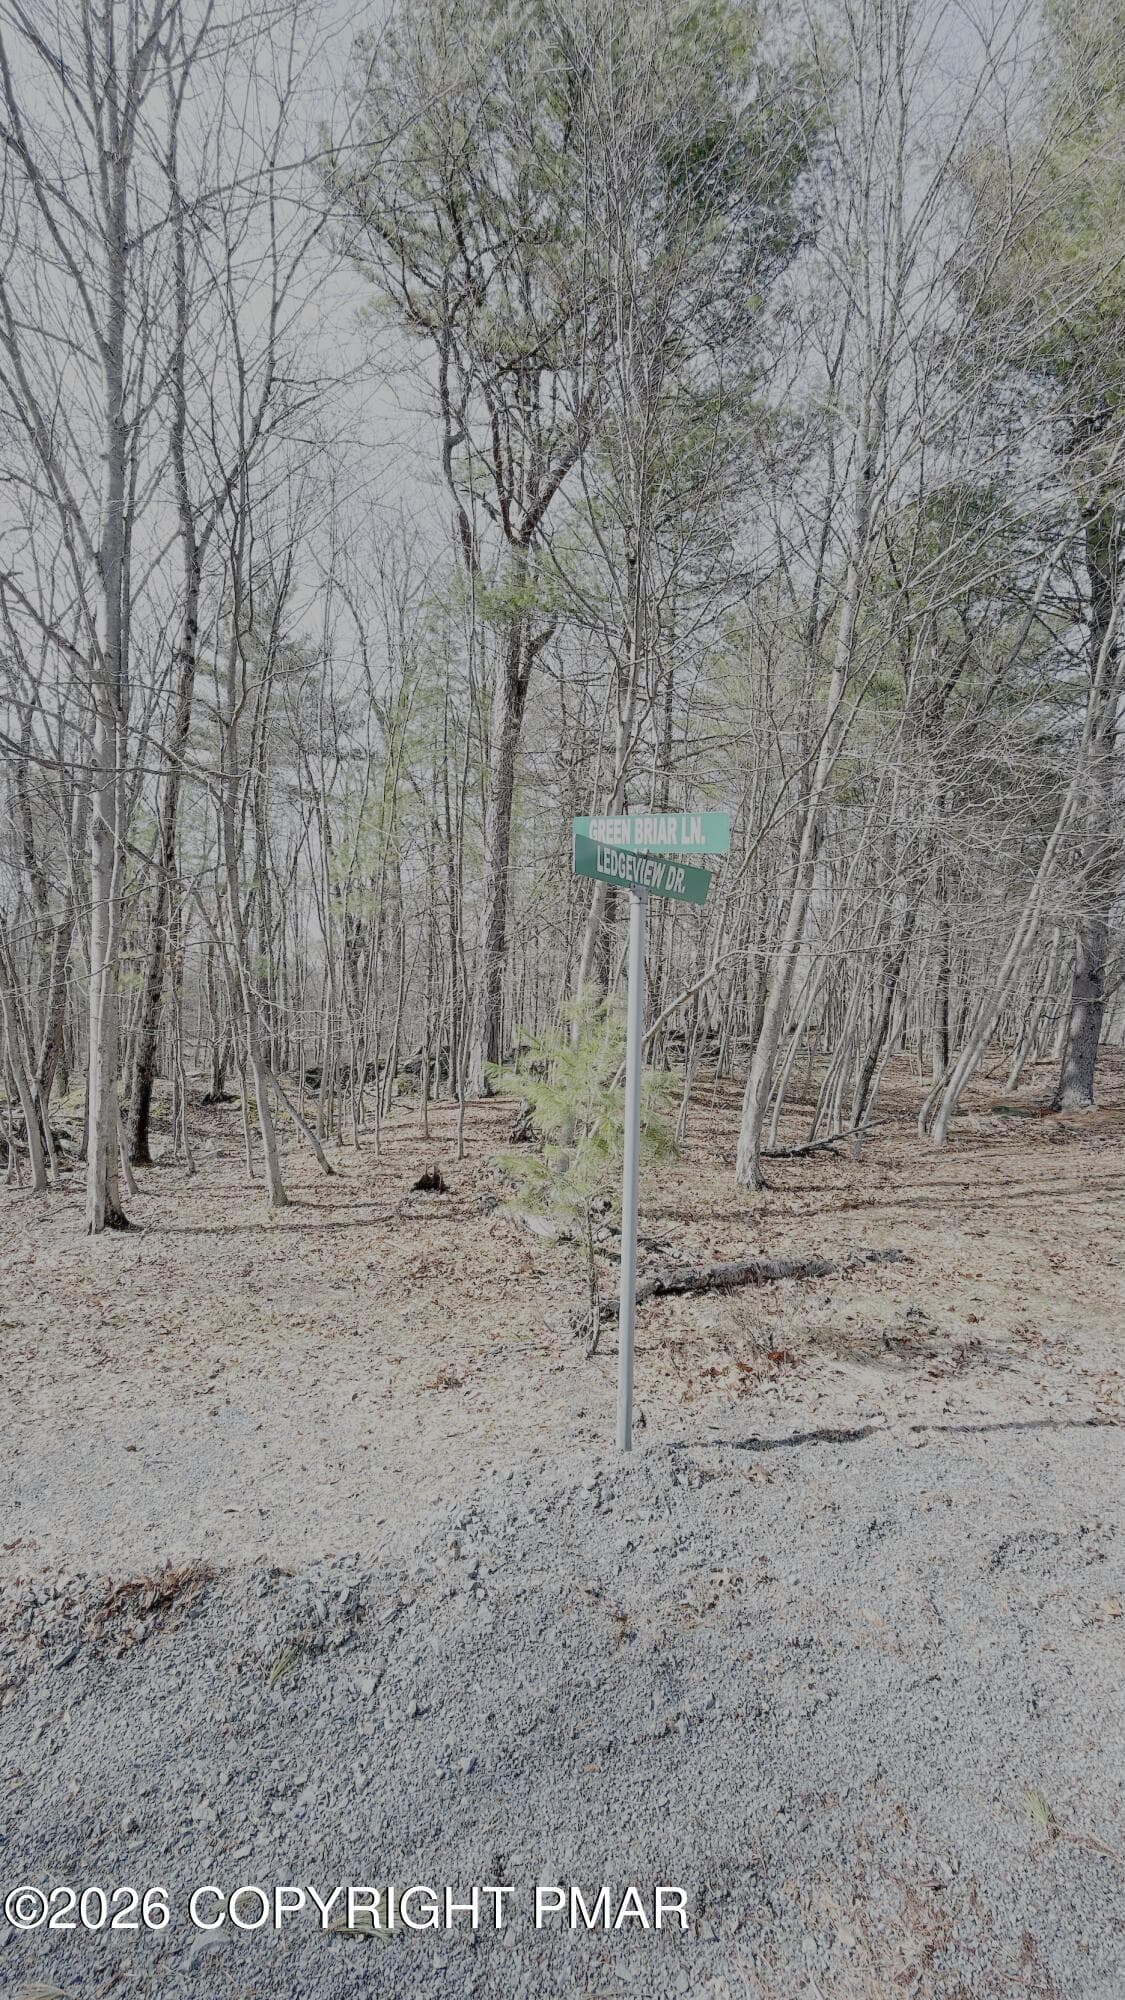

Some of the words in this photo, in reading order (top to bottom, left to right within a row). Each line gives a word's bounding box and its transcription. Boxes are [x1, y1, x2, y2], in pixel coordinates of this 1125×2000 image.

[589, 818, 631, 845] GREEN
[635, 817, 677, 845] BRIAR
[681, 816, 705, 844] LN.
[597, 845, 666, 888] LEDGEVIEW
[666, 865, 686, 894] DR.
